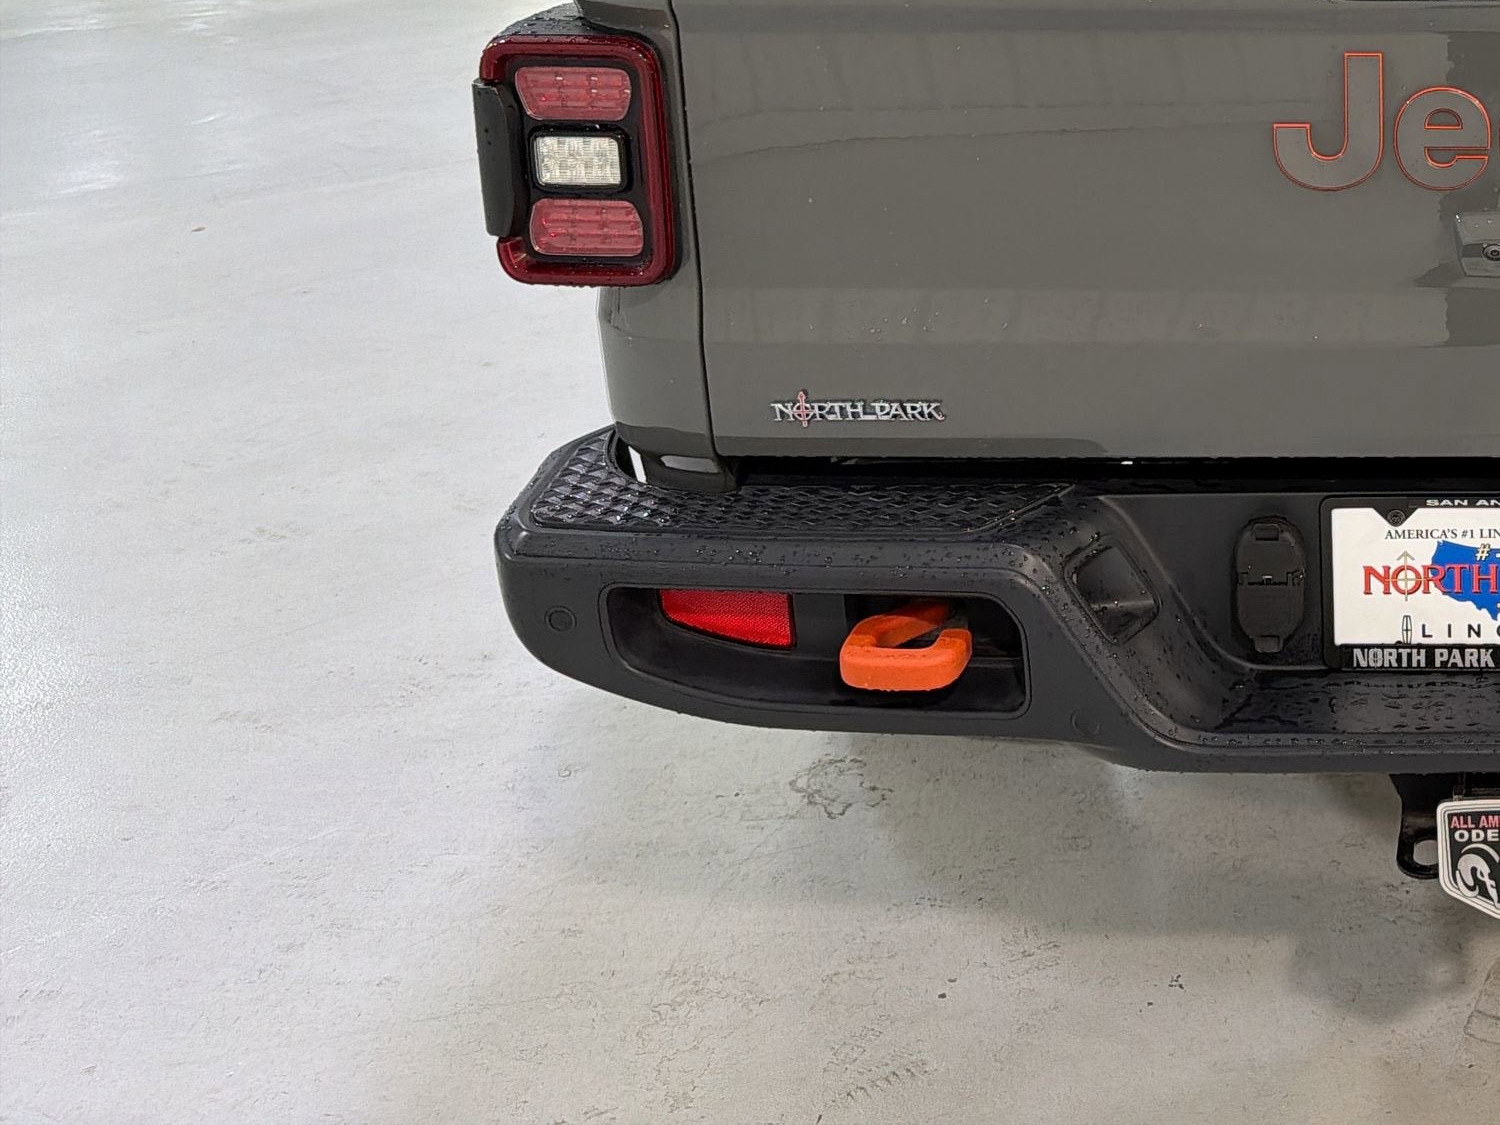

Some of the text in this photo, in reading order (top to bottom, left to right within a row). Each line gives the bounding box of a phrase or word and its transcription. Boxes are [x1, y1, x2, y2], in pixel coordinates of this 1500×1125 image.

[770, 400, 946, 423] NORTH PARK
[1426, 499, 1468, 507] SAN
[1385, 528, 1458, 540] AMERICA'S
[1461, 528, 1475, 540] #1
[1362, 563, 1500, 595] NORTH
[1352, 647, 1427, 669] NORTH
[1433, 647, 1496, 669] PARK
[1450, 815, 1476, 829] ALL
